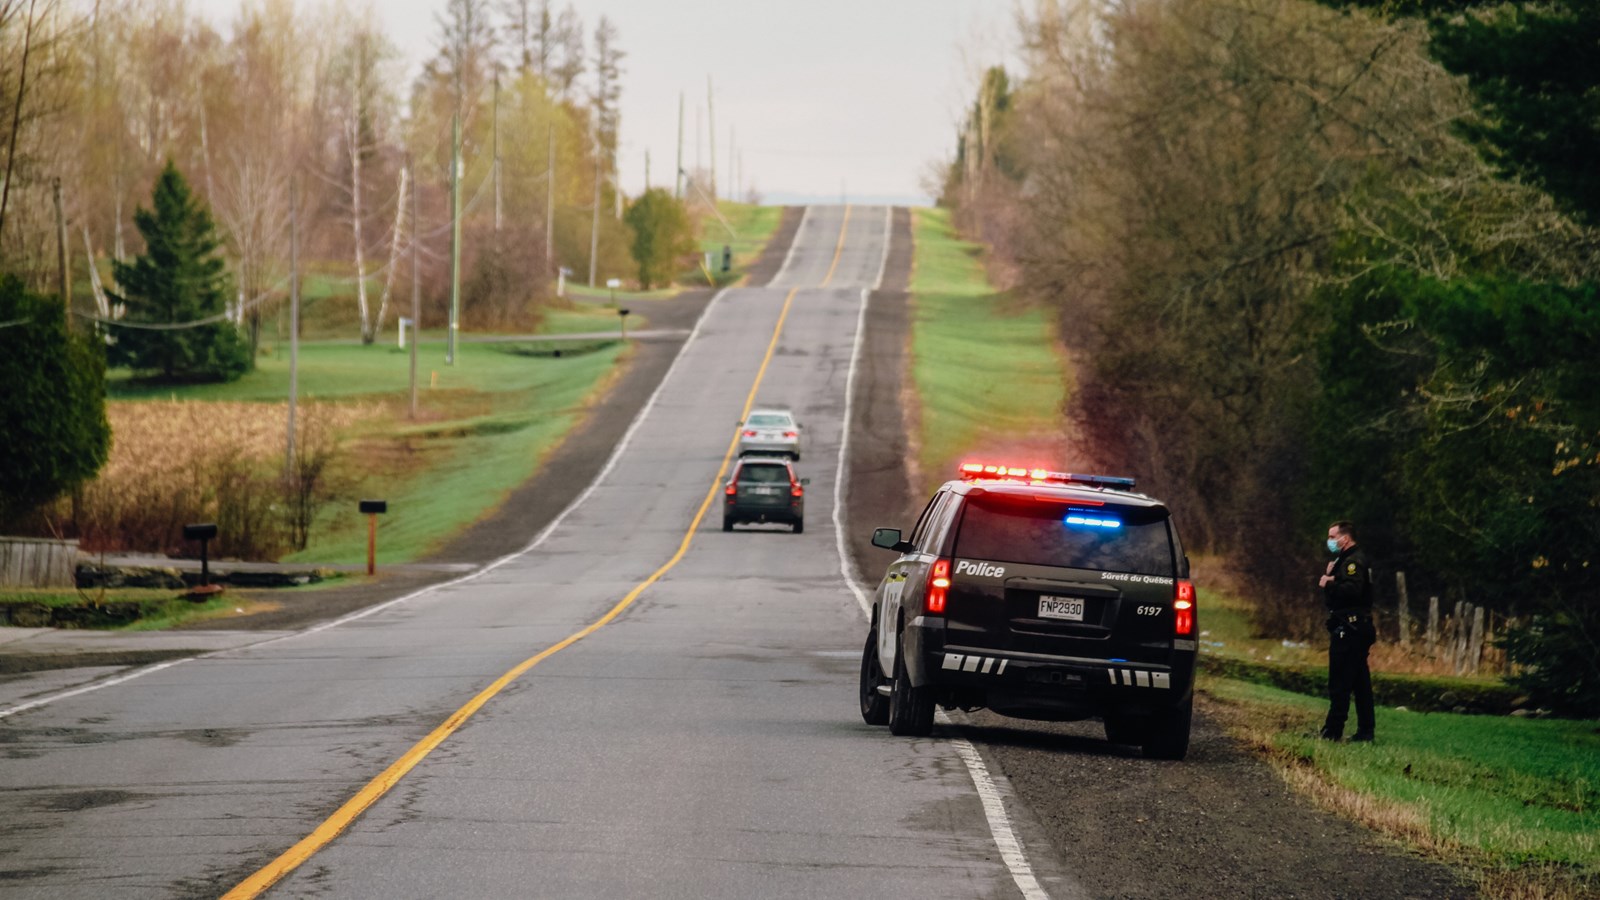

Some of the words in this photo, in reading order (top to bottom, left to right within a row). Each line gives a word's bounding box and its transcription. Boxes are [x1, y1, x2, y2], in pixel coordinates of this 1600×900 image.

[955, 561, 1005, 578] Police
[1101, 572, 1129, 581] Sûreté
[1130, 574, 1142, 582] du
[1143, 575, 1174, 585] Québec
[1040, 600, 1082, 615] FNP2930
[1136, 605, 1162, 616] 6197
